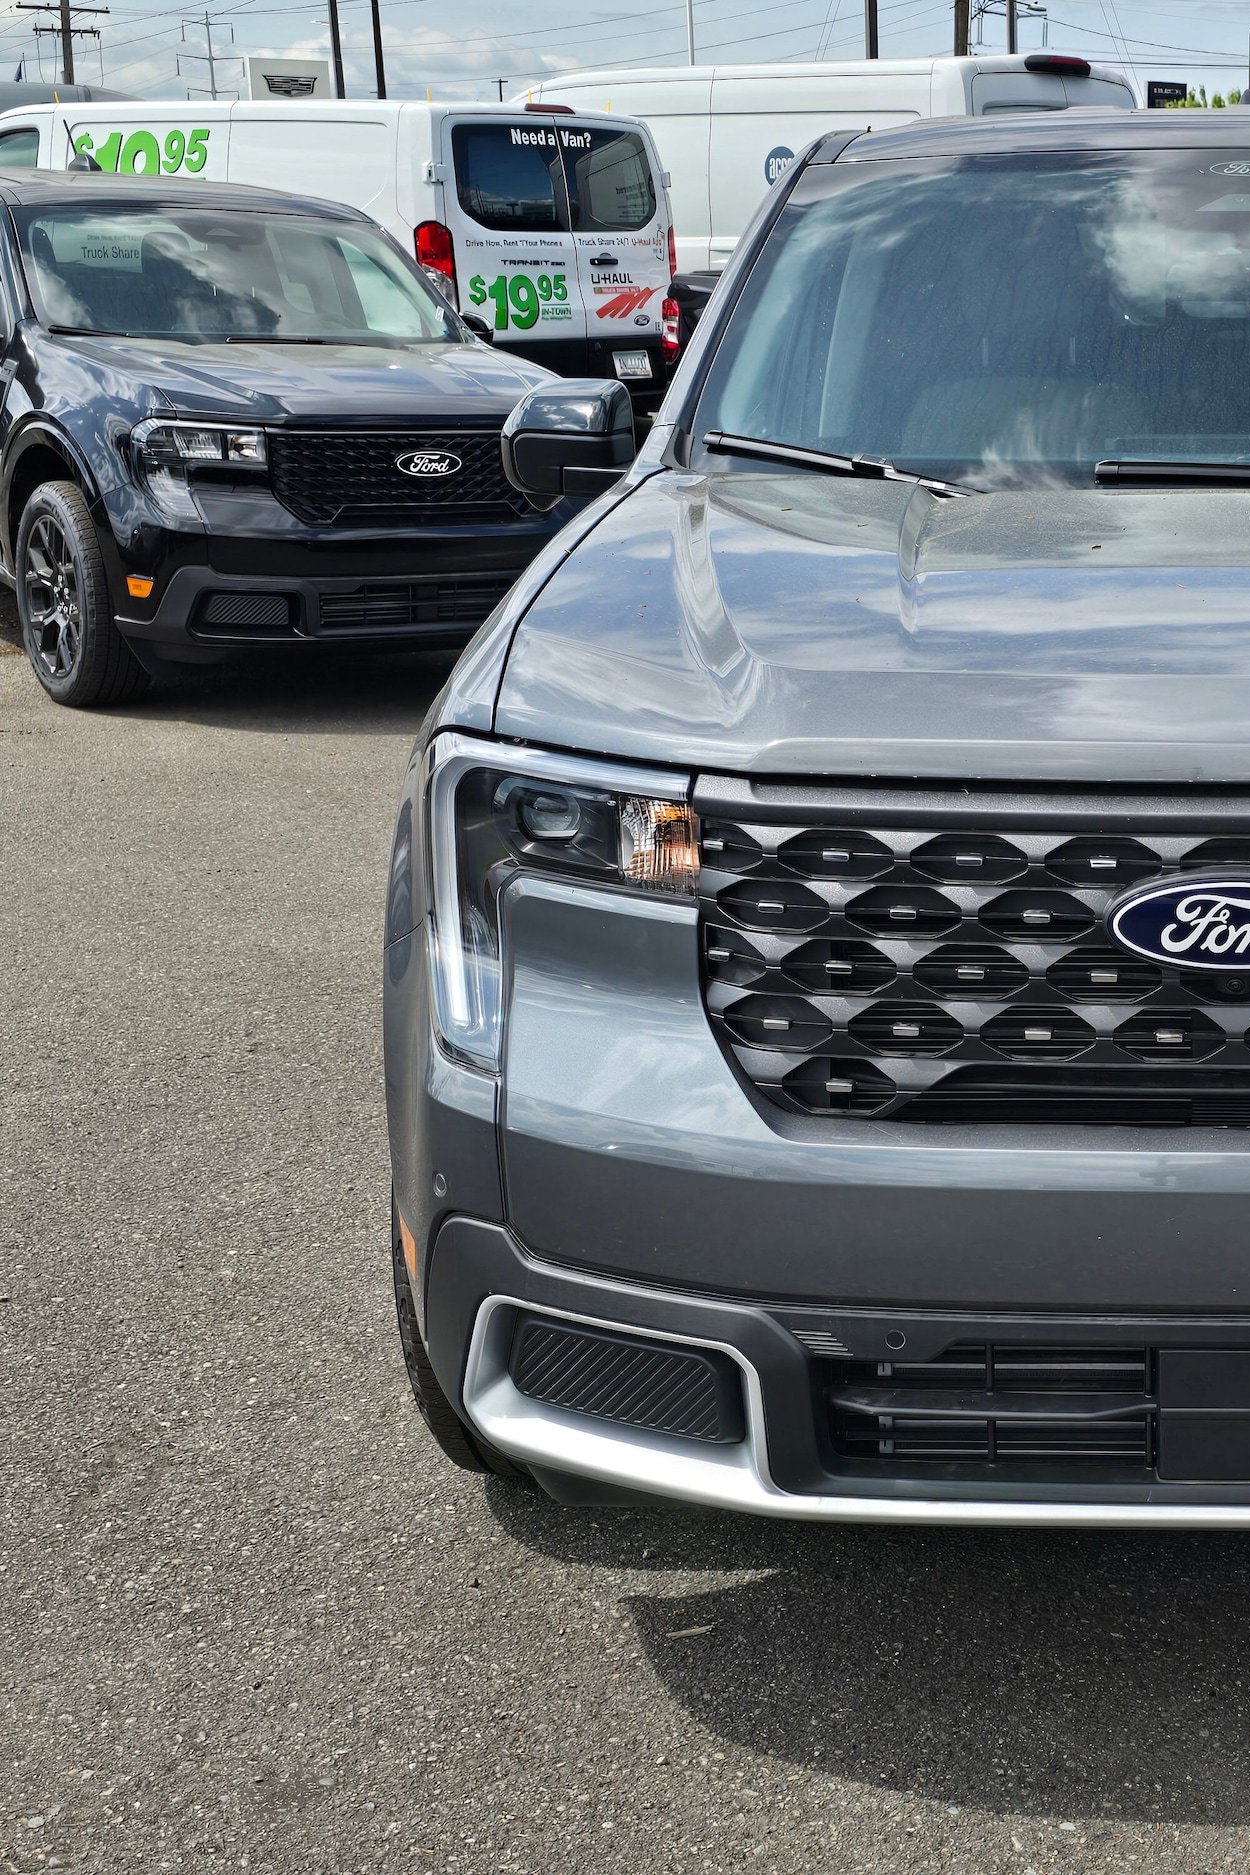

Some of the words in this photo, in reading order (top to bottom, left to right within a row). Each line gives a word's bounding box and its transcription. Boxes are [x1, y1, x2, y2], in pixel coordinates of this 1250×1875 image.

[510, 128, 546, 145] Need
[547, 133, 556, 146] a
[560, 130, 592, 148] Van?
[81, 246, 109, 259] Truck
[111, 246, 140, 259] Share
[591, 272, 634, 284] U-HAUL
[409, 454, 450, 472] Ford
